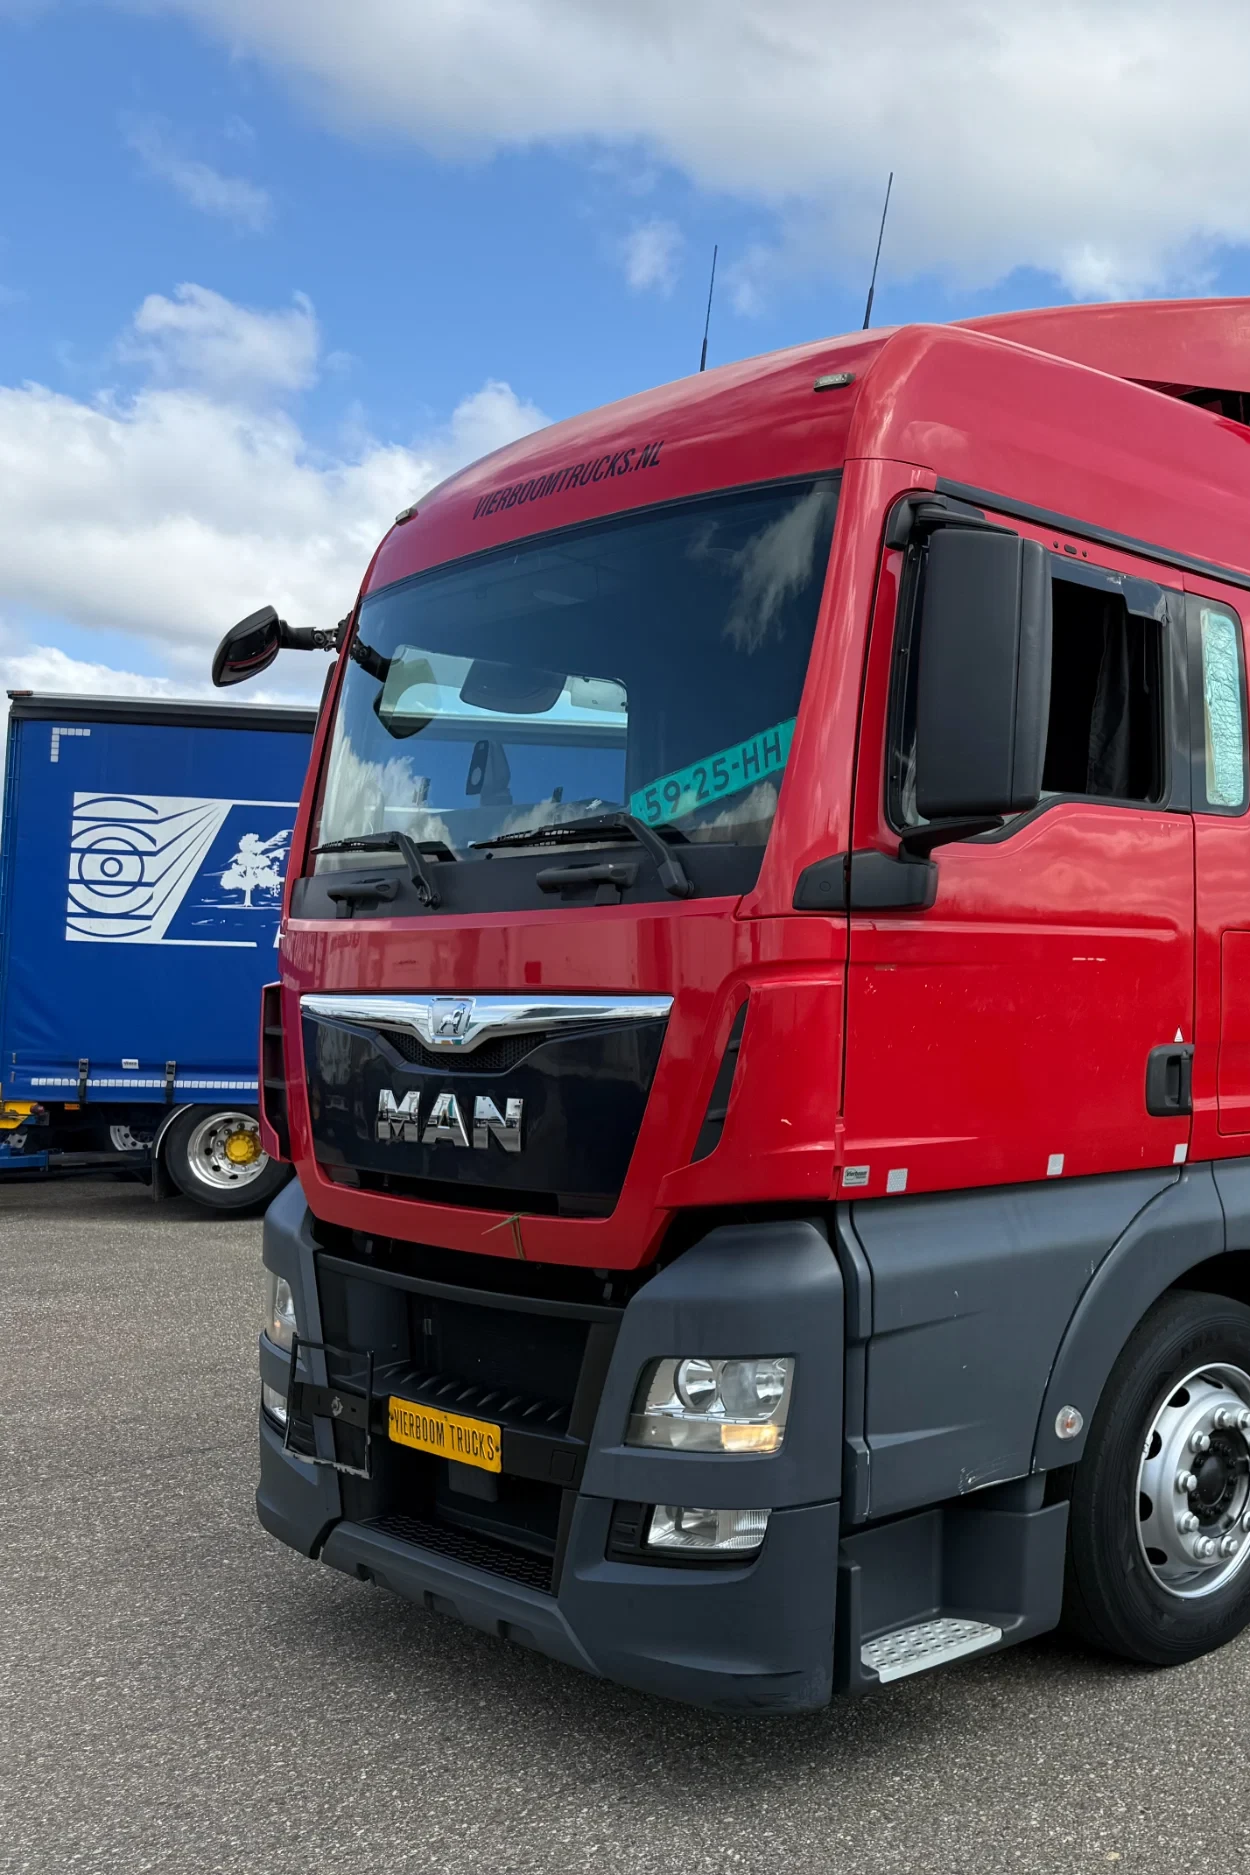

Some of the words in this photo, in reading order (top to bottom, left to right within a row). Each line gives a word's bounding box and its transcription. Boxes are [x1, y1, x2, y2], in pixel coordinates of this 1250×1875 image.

[472, 440, 665, 520] VIERBOOMTRUCKS.NL
[644, 731, 782, 822] 59-25-HH
[376, 1088, 524, 1152] MAN
[393, 1408, 445, 1448] VIERBOOM
[449, 1424, 495, 1461] TRUCKS
